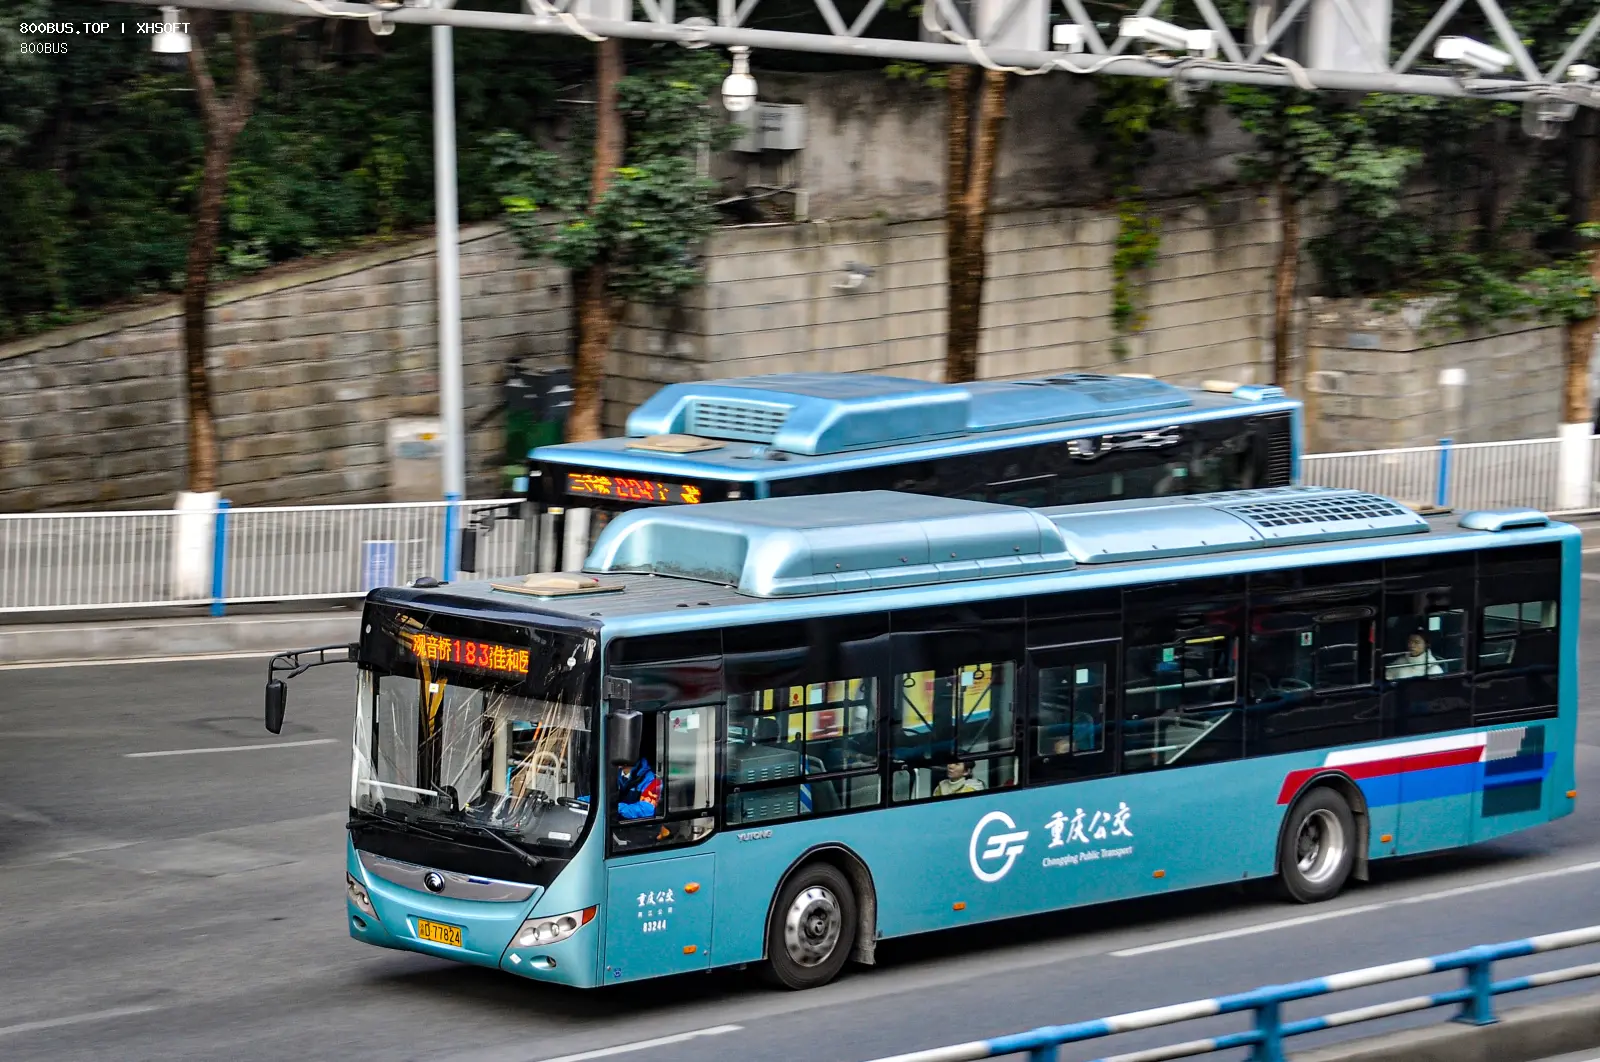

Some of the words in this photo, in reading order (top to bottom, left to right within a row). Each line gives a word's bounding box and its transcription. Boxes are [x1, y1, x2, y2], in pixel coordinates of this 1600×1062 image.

[453, 640, 489, 667] 183
[1044, 801, 1134, 848] 重庆公交
[737, 829, 773, 842] YUTONG
[1079, 850, 1100, 861] Public
[1100, 846, 1133, 858] Transport
[636, 888, 675, 907] 重庆公交
